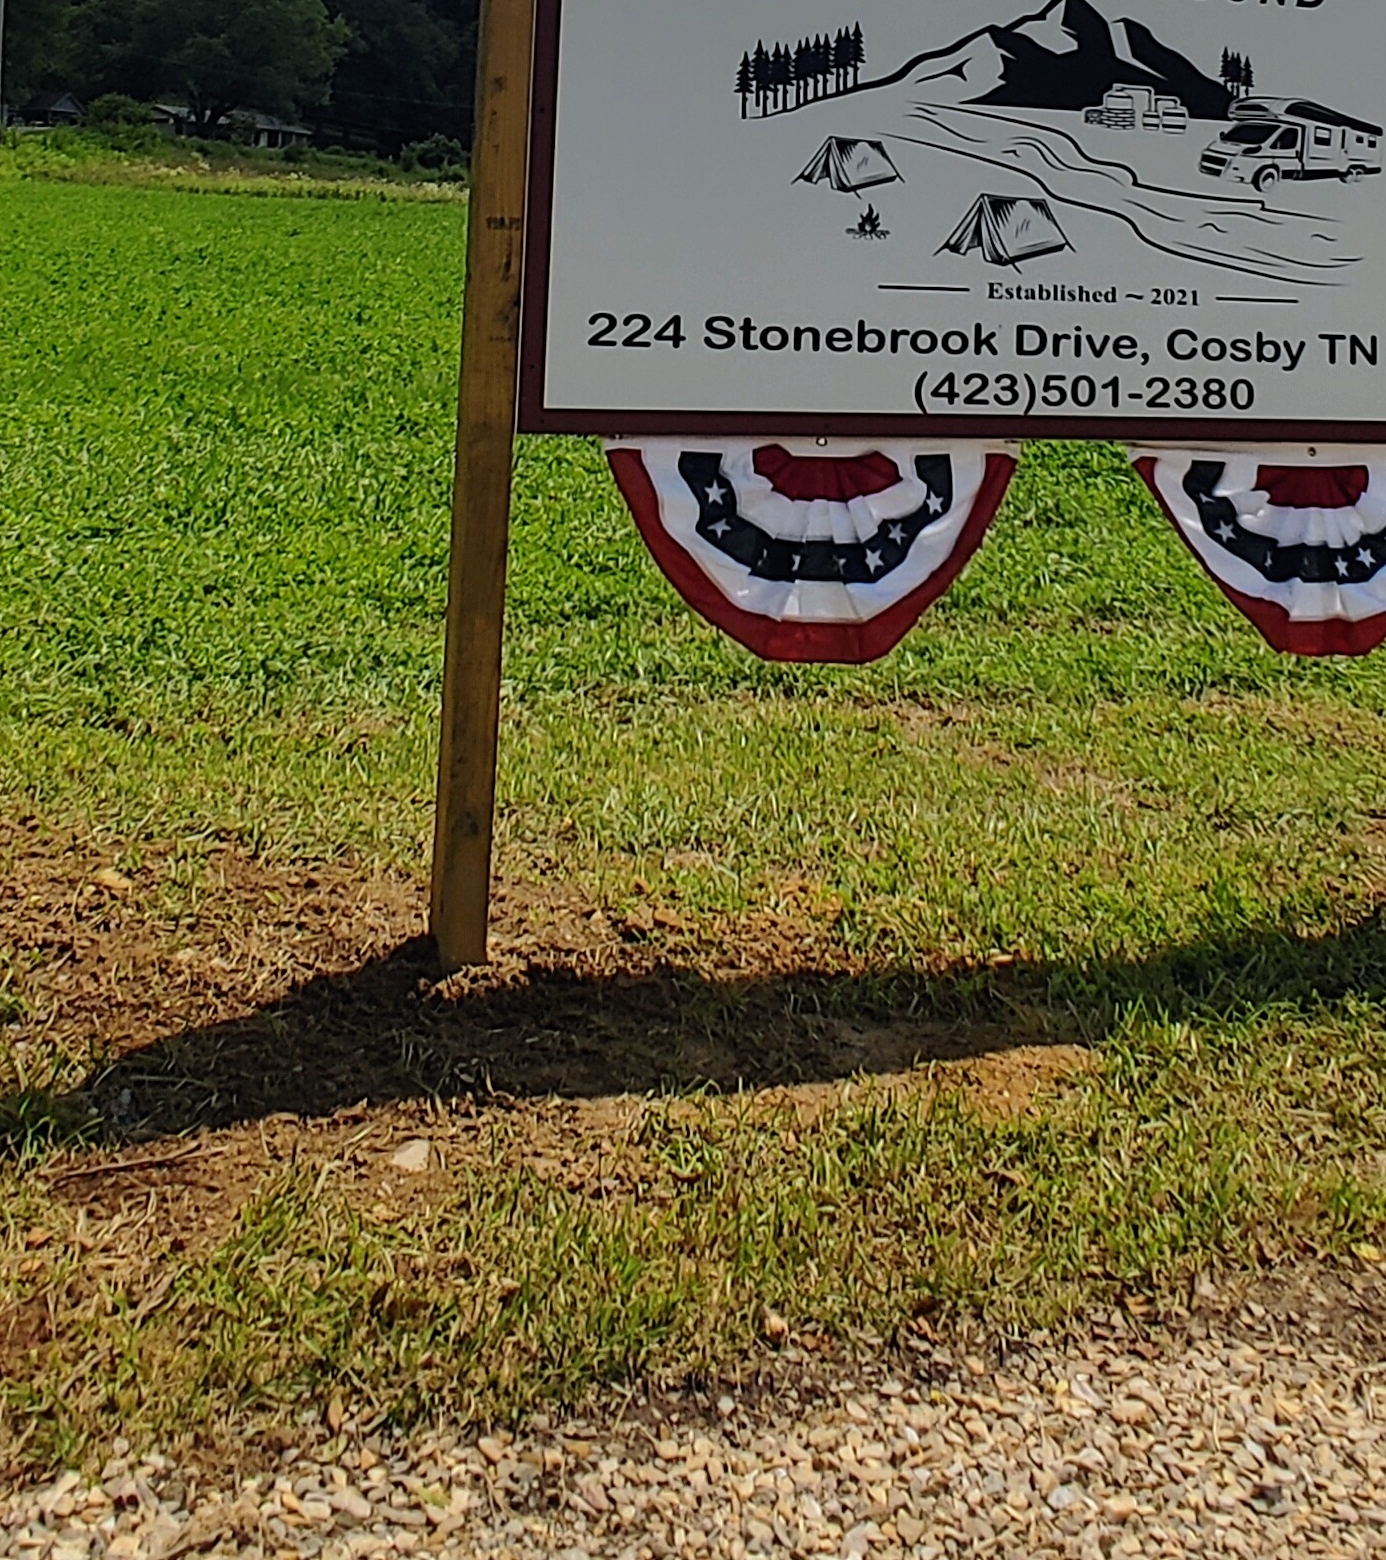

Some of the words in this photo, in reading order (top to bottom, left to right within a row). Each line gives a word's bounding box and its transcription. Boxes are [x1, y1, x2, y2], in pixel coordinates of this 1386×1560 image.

[988, 282, 1117, 303] Established
[1150, 288, 1199, 306] 2021
[587, 312, 687, 349] 224
[703, 315, 999, 356] Stonebrook
[1015, 324, 1150, 366] Drive,
[1166, 328, 1306, 372] Cosby
[1317, 333, 1378, 366] TN
[912, 370, 1255, 415] (423)501-2380
